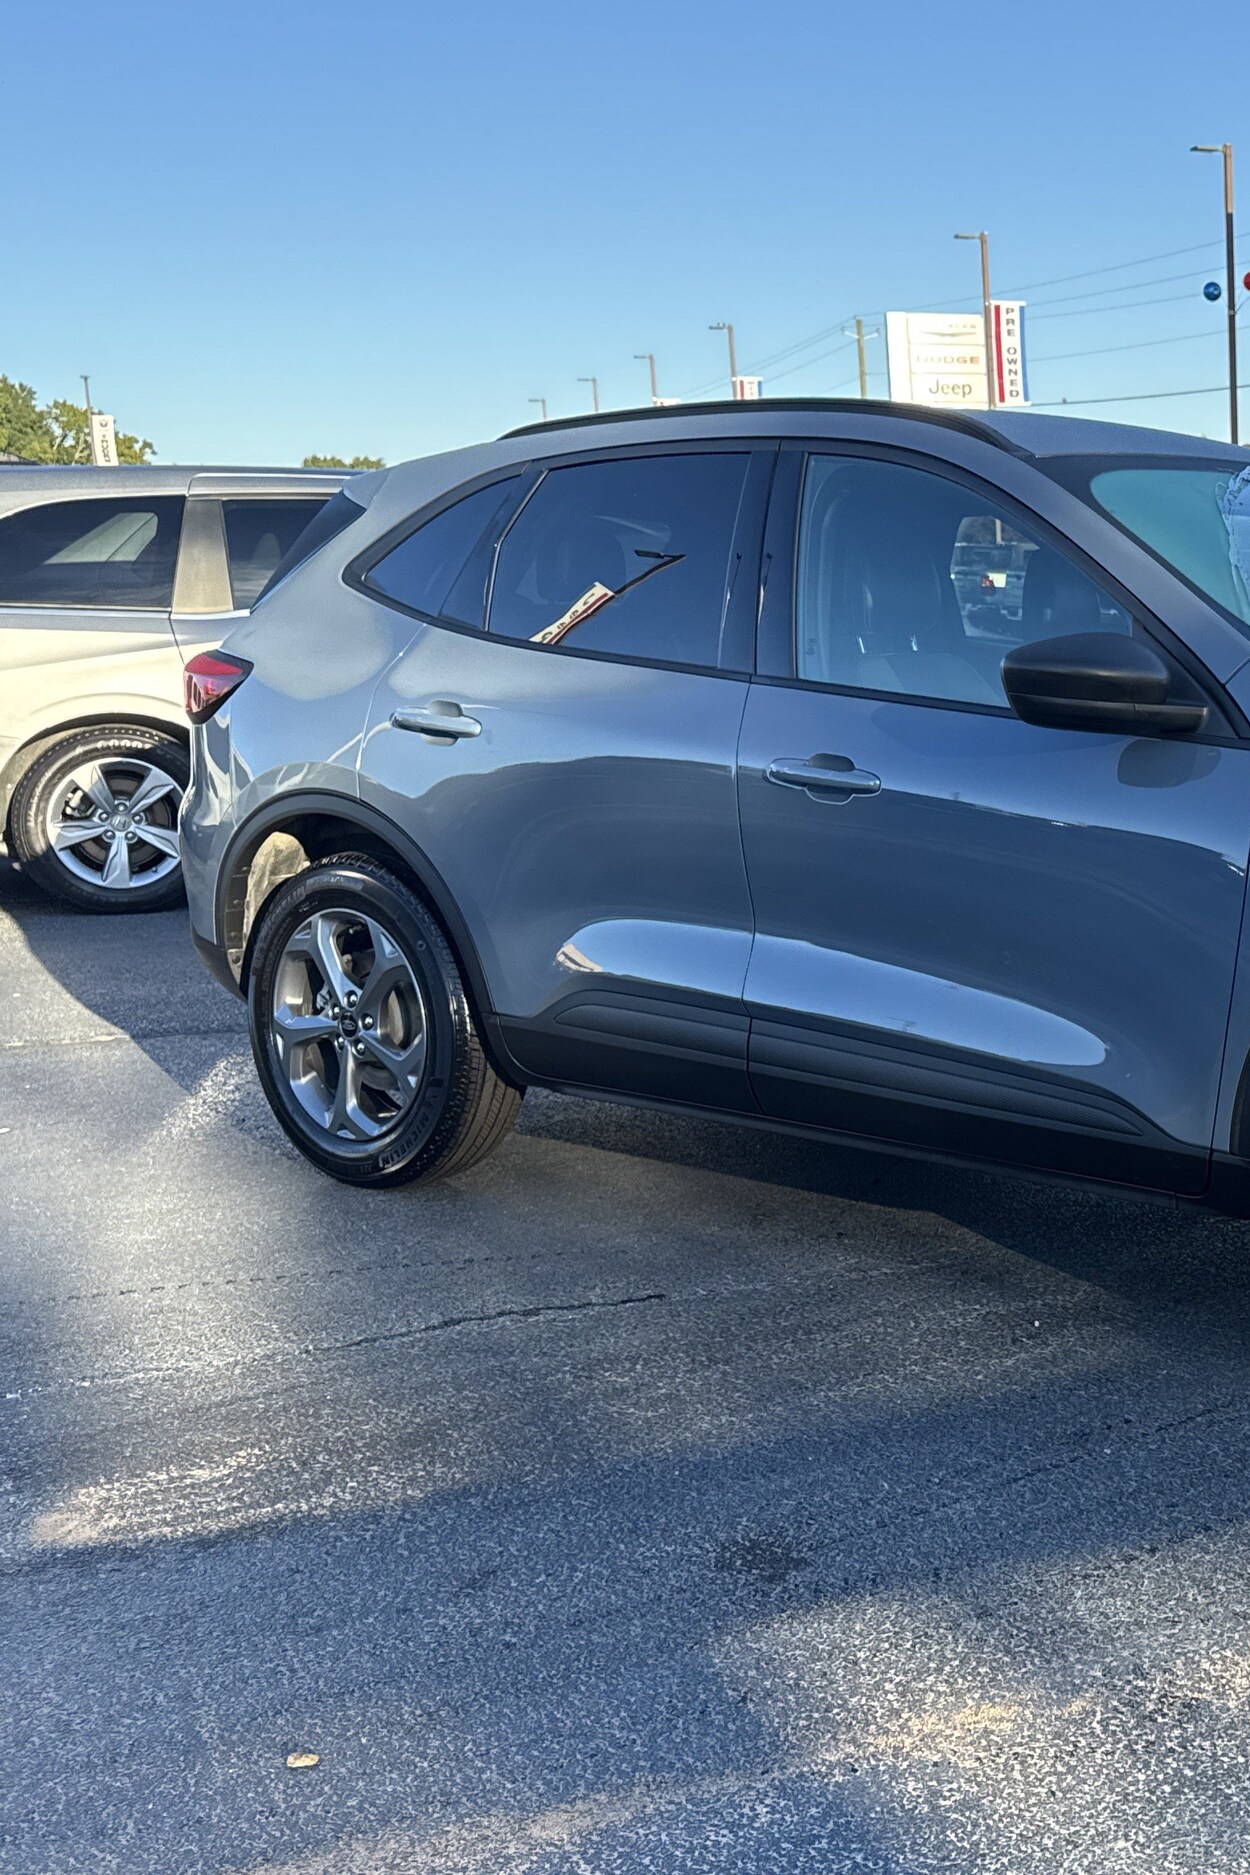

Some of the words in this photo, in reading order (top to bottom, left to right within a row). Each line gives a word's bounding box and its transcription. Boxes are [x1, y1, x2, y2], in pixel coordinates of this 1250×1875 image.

[1005, 307, 1016, 337] PRE
[1006, 346, 1020, 398] OWNED
[928, 379, 973, 399] Jeep
